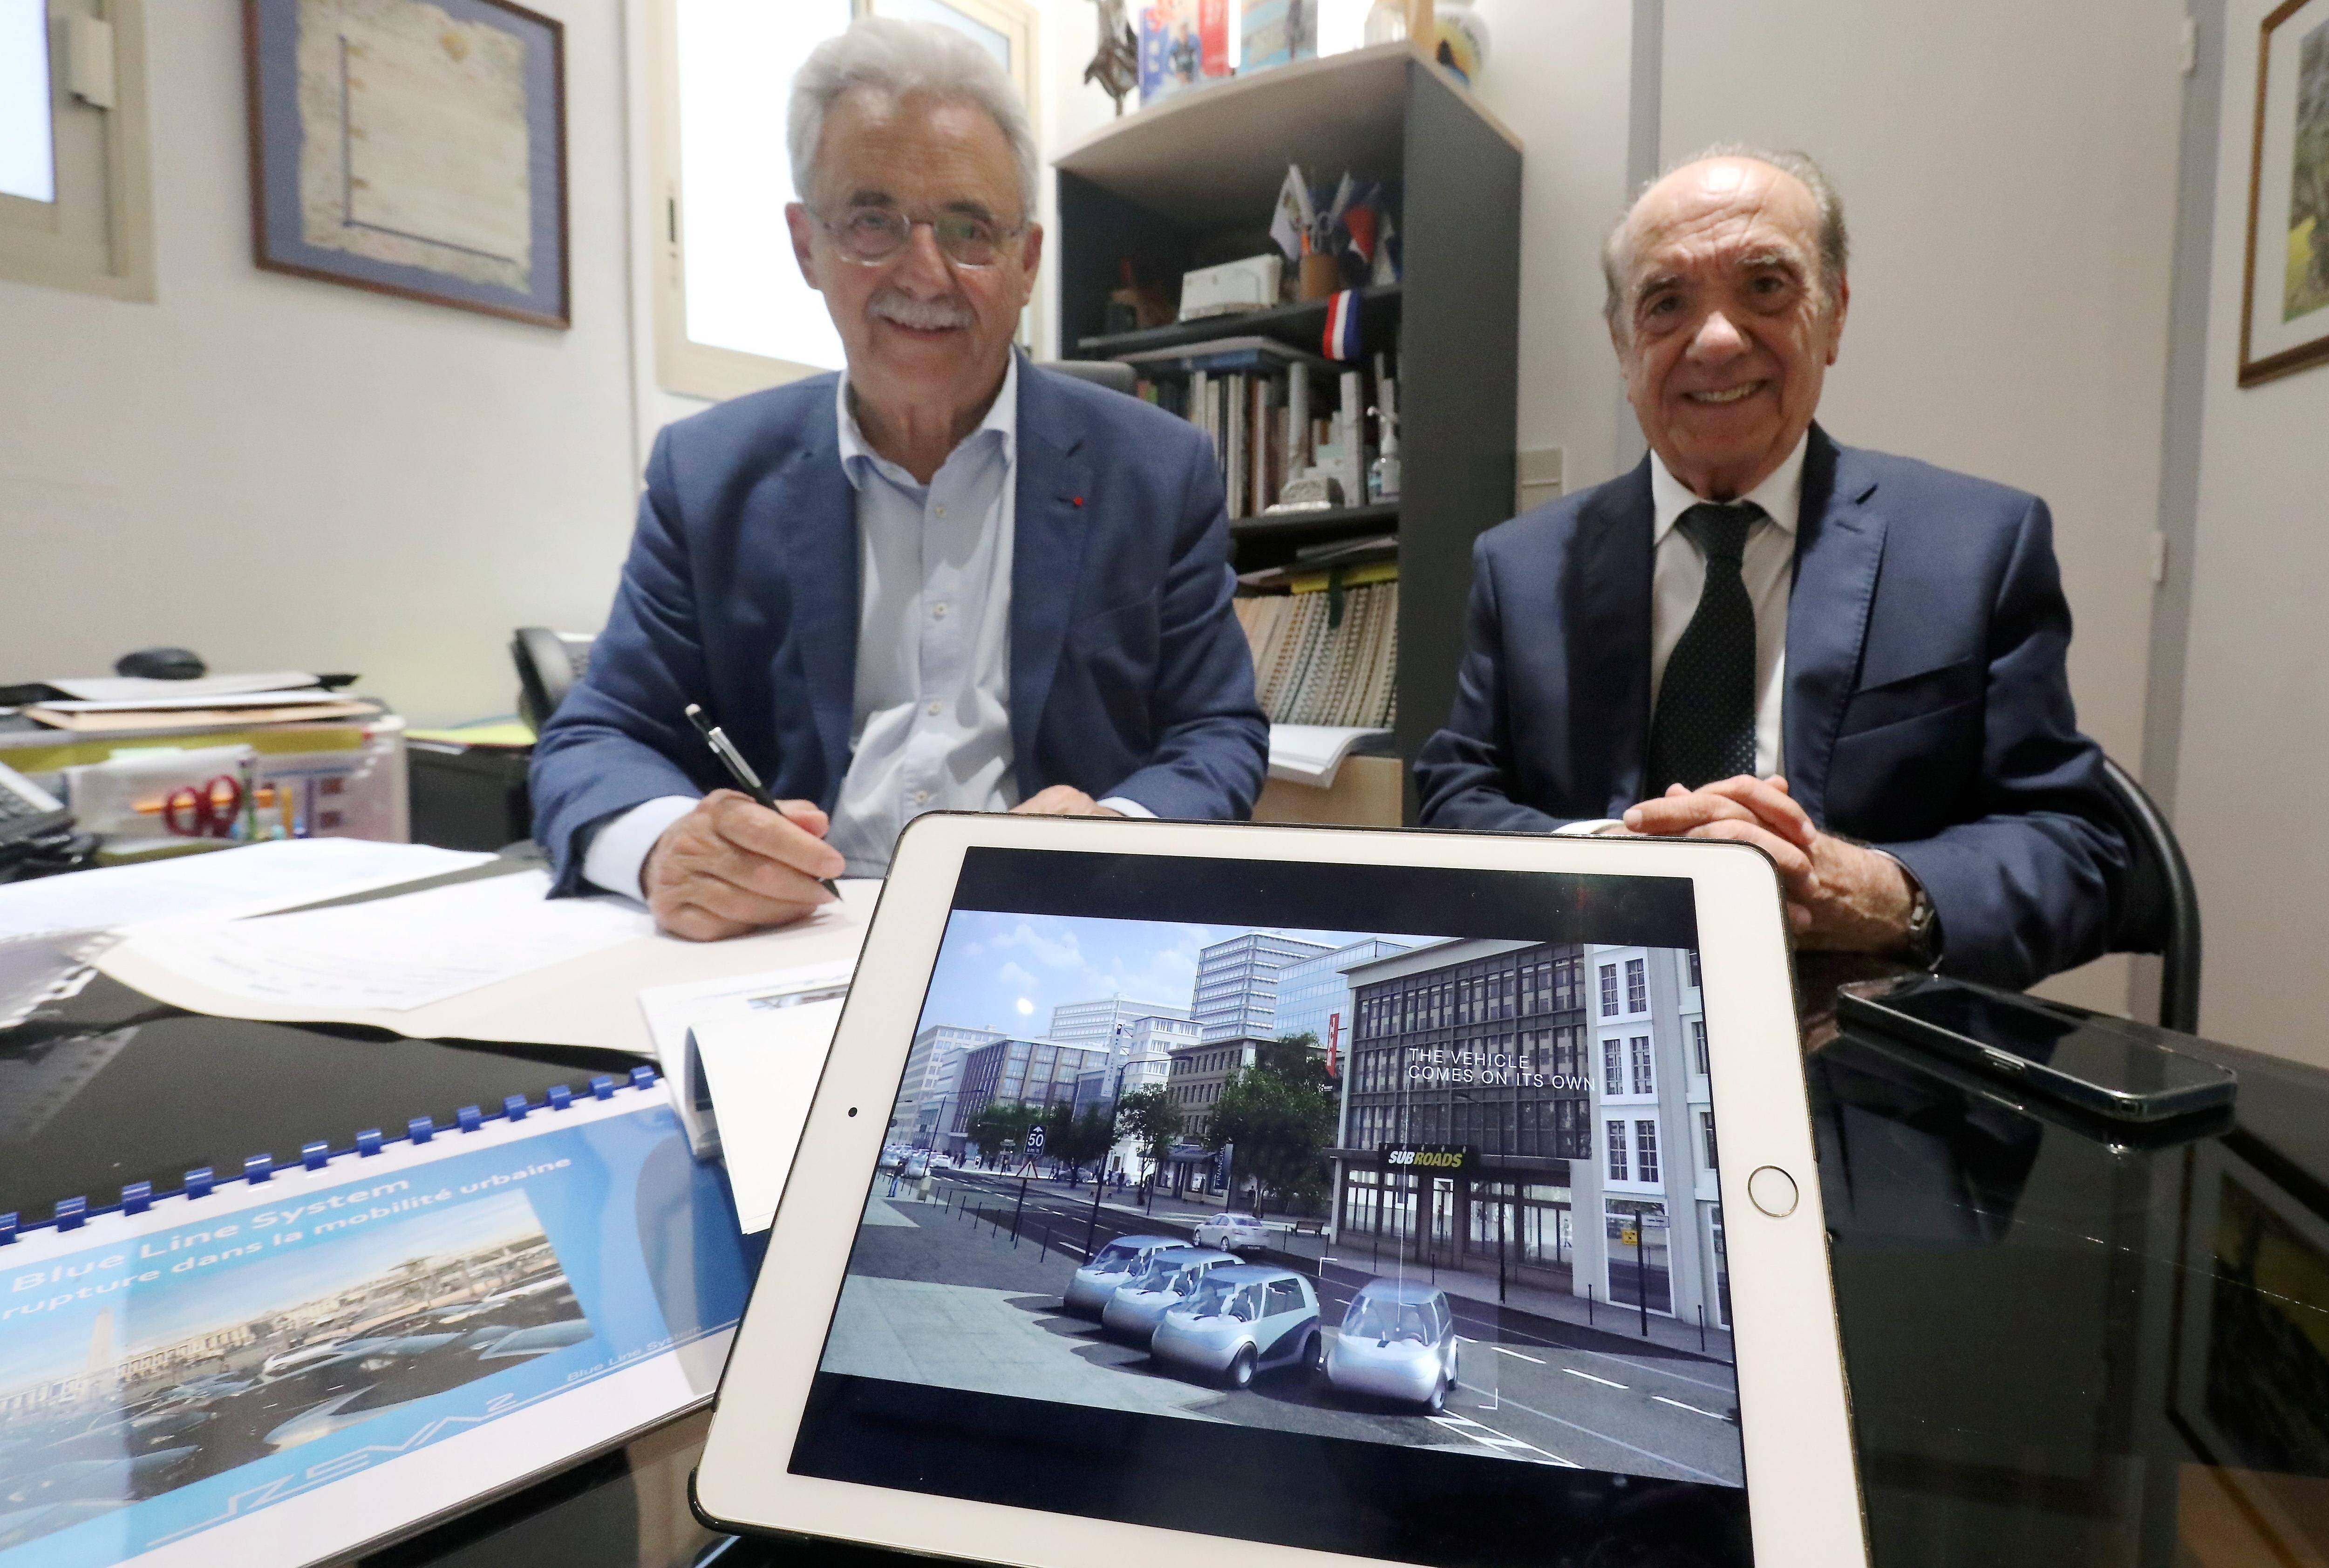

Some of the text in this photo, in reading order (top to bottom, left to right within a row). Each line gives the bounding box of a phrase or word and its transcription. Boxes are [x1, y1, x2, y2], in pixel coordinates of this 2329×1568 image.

[1409, 1048, 1529, 1069] THE VEHICLE
[1408, 1065, 1595, 1091] COMES ON ITS OWN
[1028, 1133, 1043, 1147] 50
[1389, 1151, 1463, 1168] SUBROADS
[2, 1158, 572, 1320] rupture dans la mobilité urbaine
[12, 1179, 409, 1293] Blue Line System
[567, 1326, 701, 1382] Blue Line System
